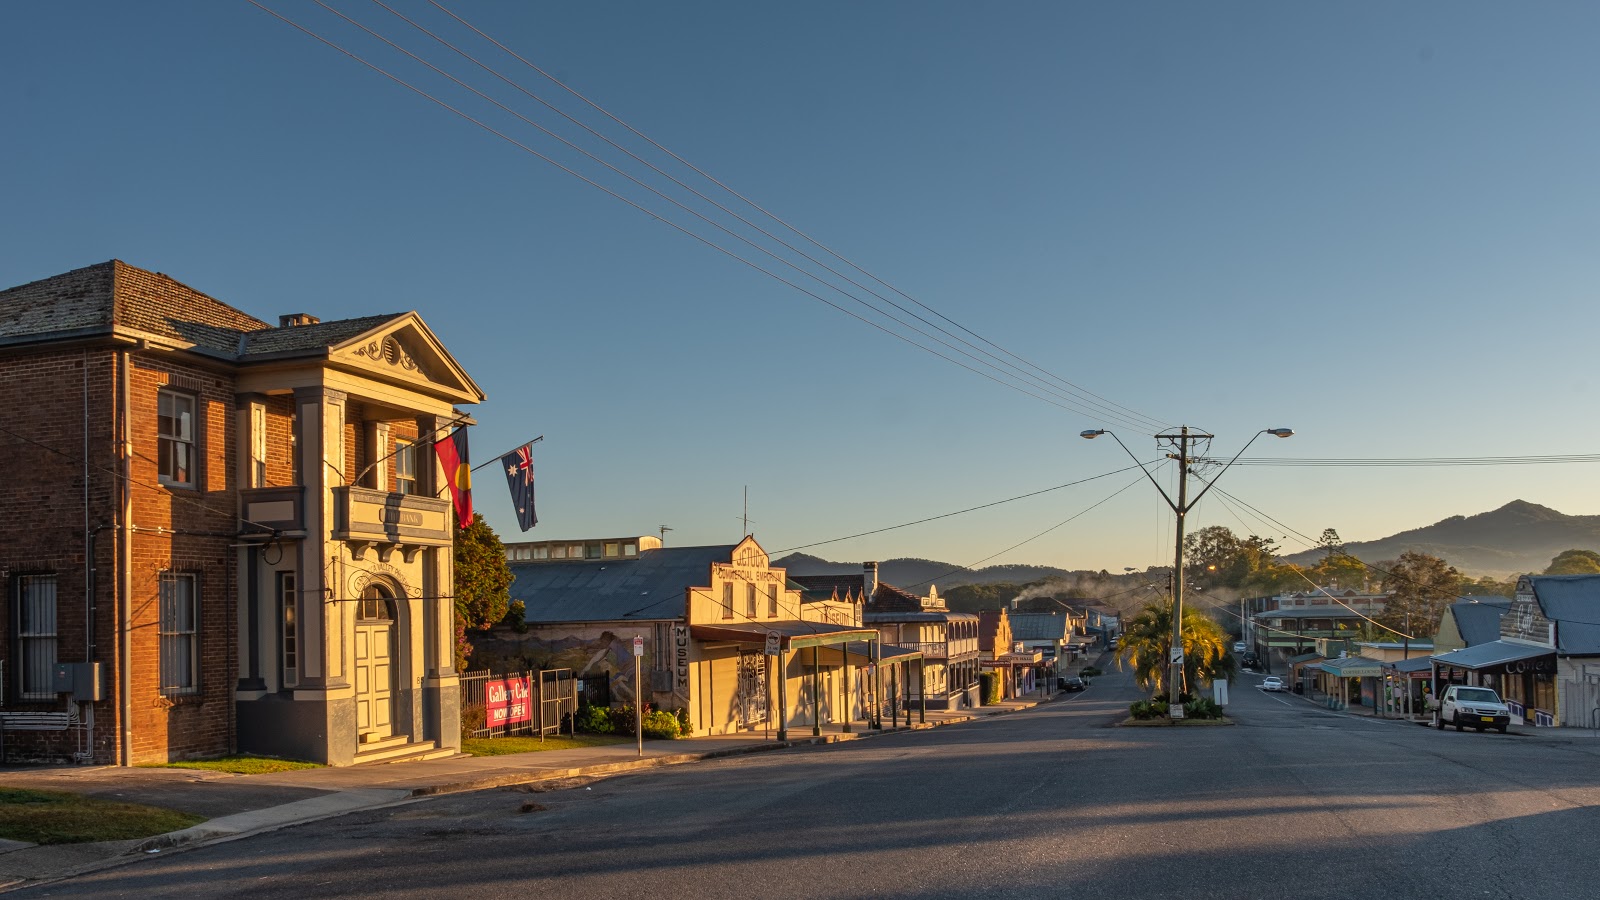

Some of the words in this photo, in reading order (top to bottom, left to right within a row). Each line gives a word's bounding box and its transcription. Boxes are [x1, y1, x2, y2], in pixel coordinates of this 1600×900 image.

[402, 513, 419, 524] BANK
[718, 568, 753, 581] COMMERCIAL
[756, 571, 782, 582] EMPORIUM
[676, 627, 688, 688] MUSEUM
[493, 708, 507, 720] NOW
[510, 705, 525, 717] OPEN
